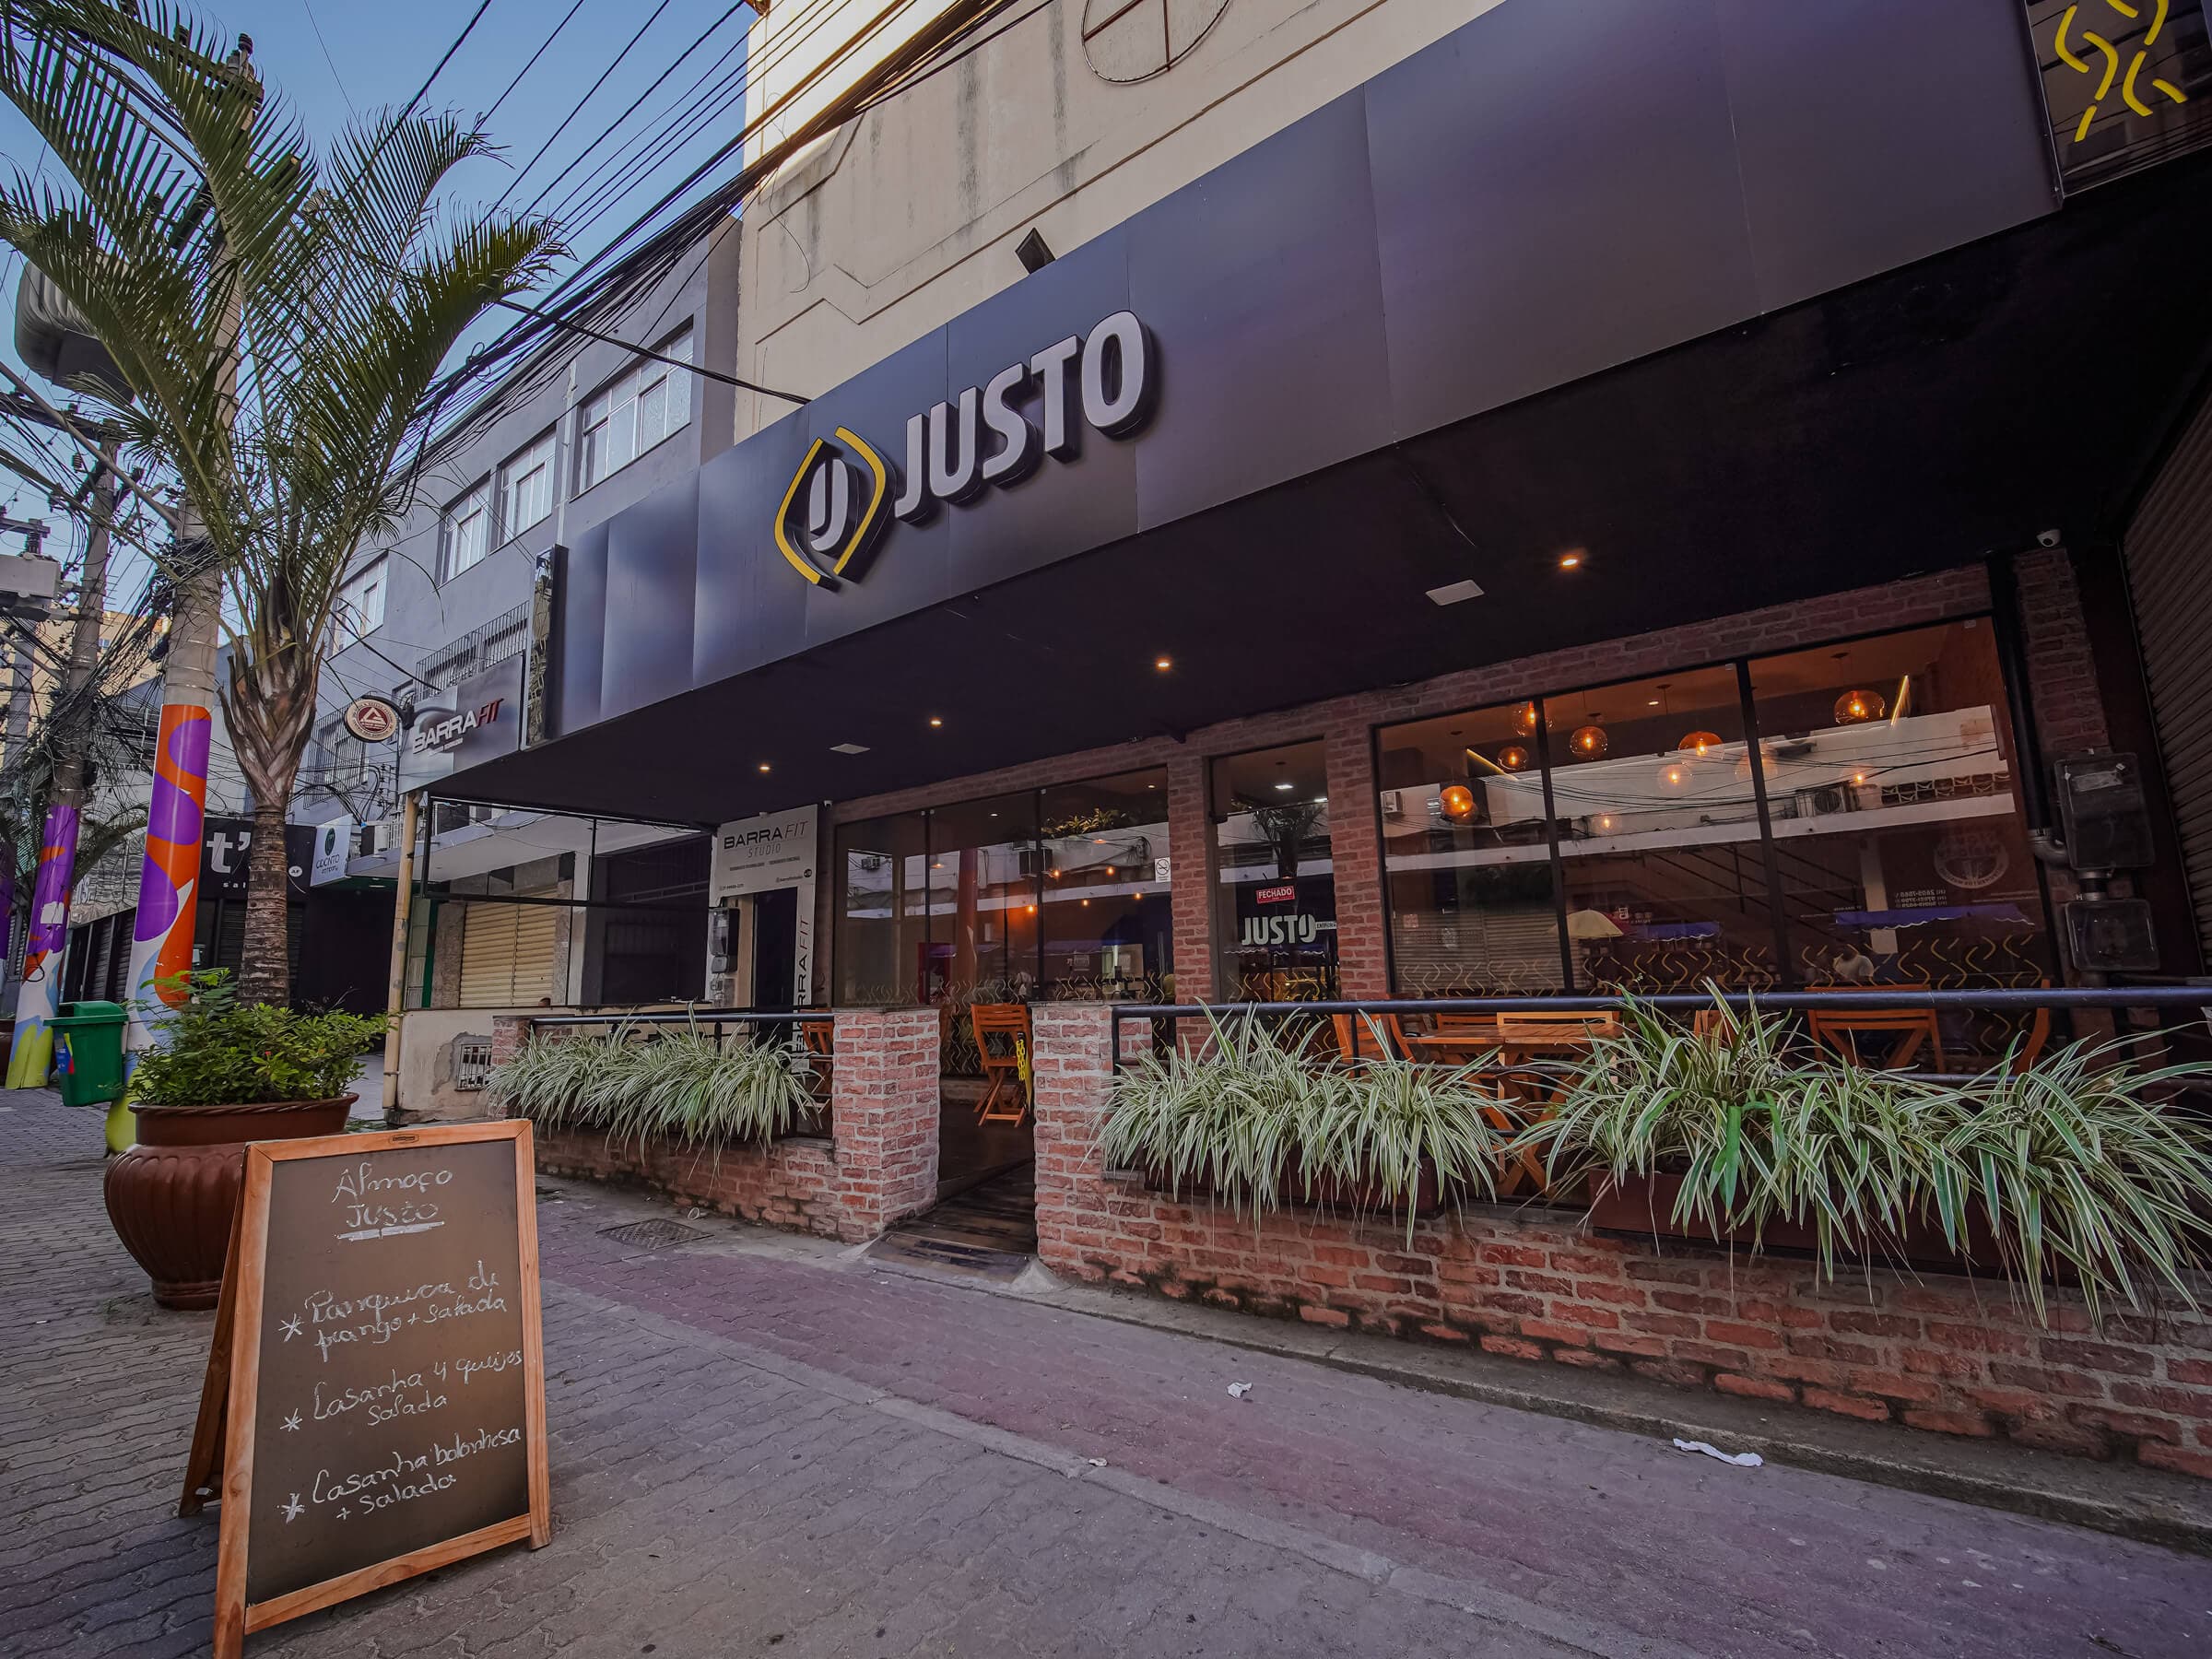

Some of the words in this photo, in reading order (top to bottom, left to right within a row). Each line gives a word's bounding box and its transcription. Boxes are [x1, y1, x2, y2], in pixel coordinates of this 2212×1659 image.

[894, 309, 1148, 520] JUSTO
[747, 843, 782, 858] STUDIO
[1258, 888, 1292, 900] FECHADO
[1241, 913, 1317, 946] JUSTO
